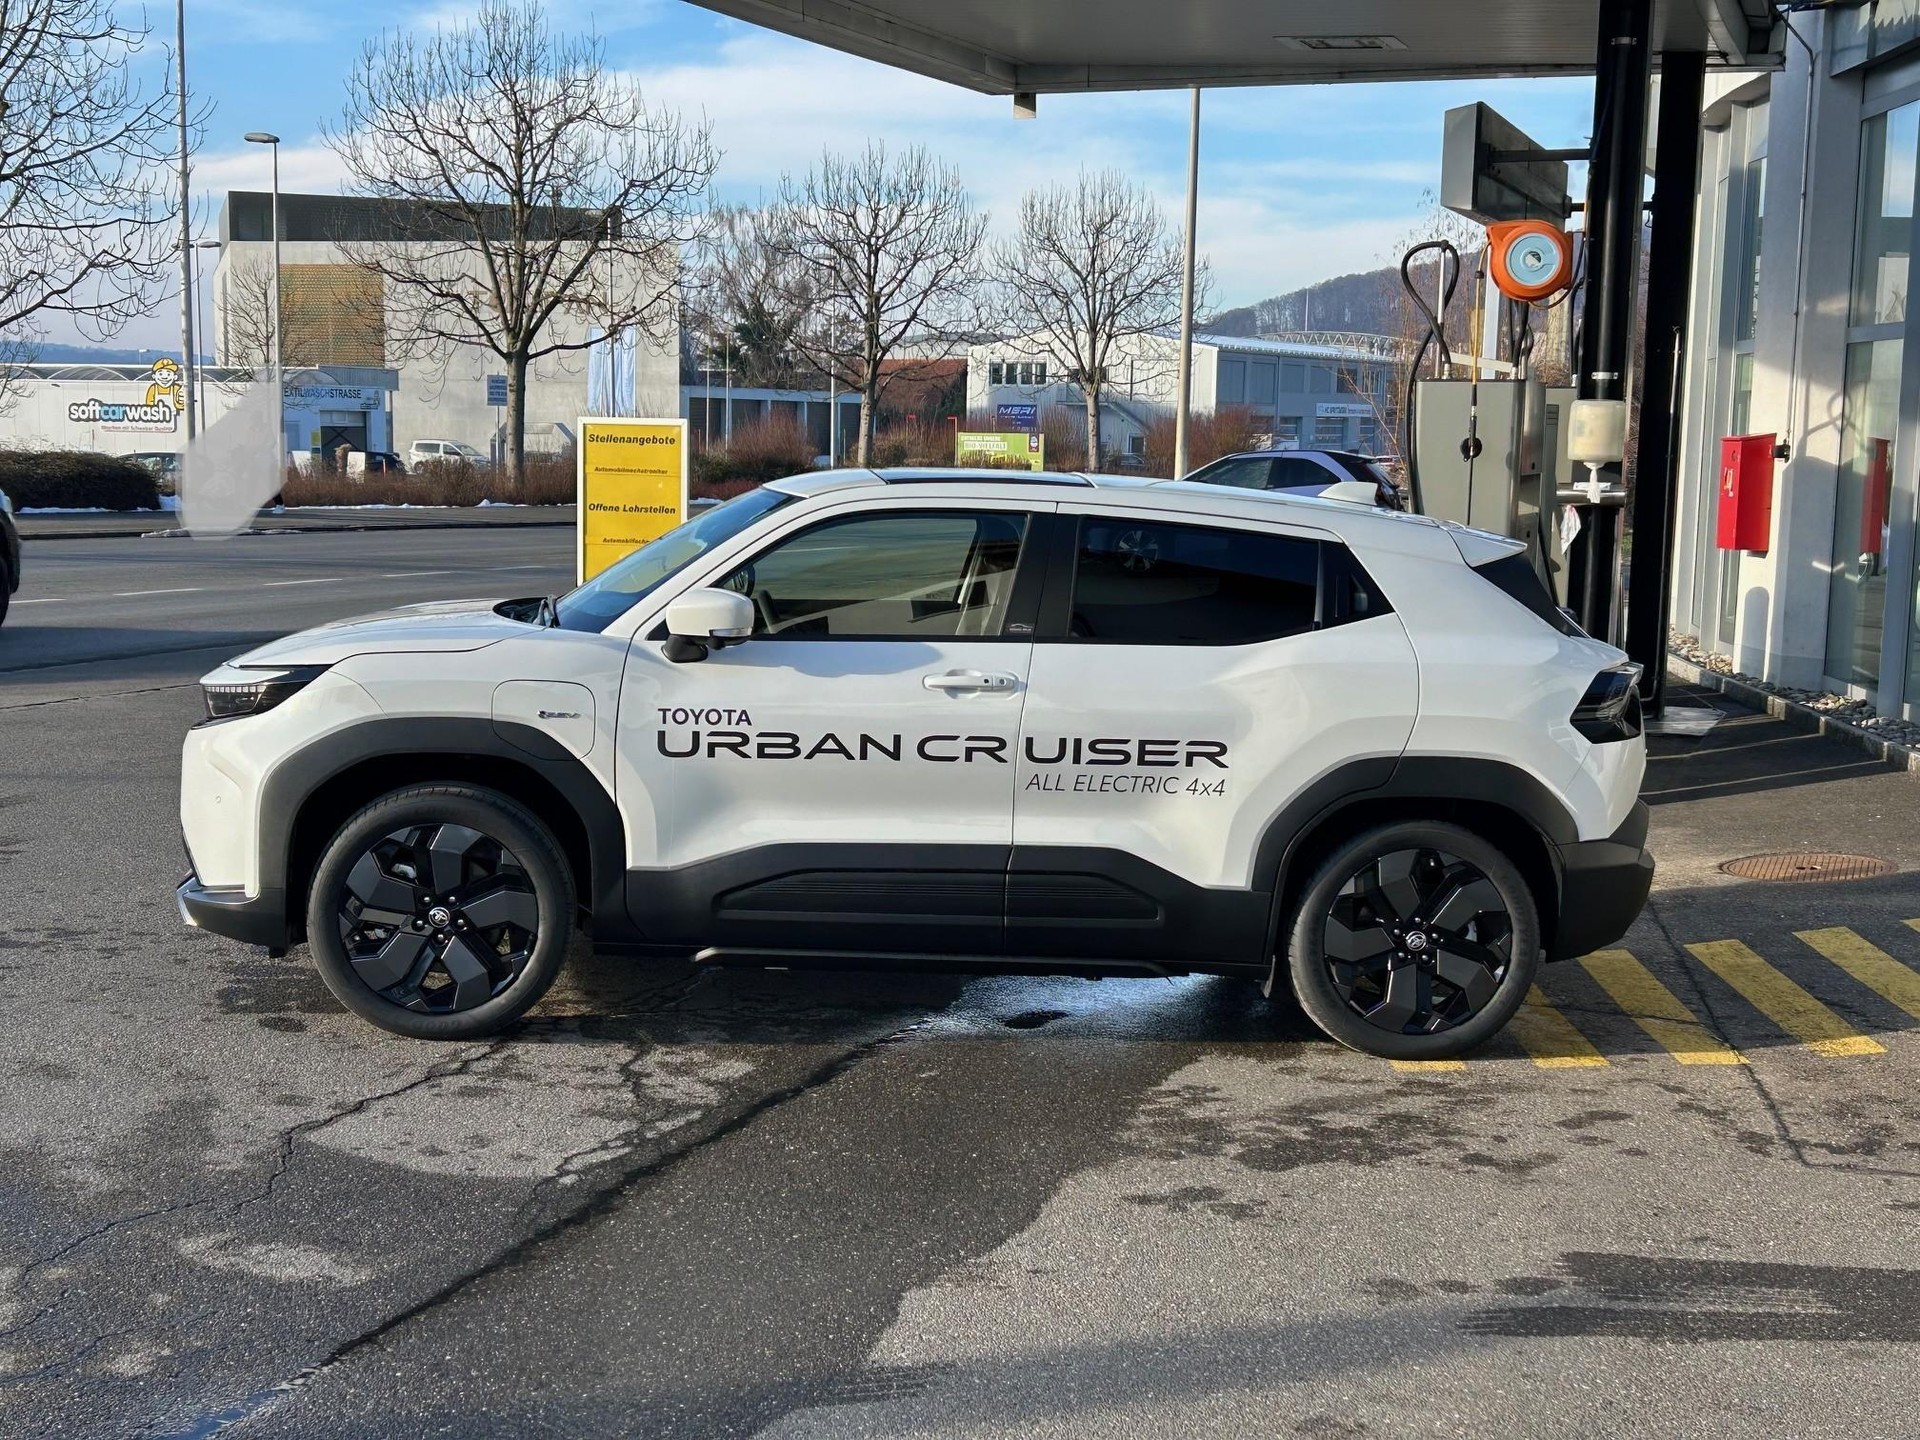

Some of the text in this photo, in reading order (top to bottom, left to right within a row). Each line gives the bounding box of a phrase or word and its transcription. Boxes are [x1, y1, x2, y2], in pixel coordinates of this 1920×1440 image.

[283, 387, 362, 399] EXTILWASCHSTRASSE
[69, 399, 172, 422] softcarwash
[588, 433, 676, 446] Stellenangebote
[588, 503, 676, 514] Offene Lehrstellen
[657, 708, 752, 726] TOYOTA
[657, 730, 1229, 768] URBAN CRUISER
[1025, 773, 1226, 797] ALL ELECTRIC 4x4
